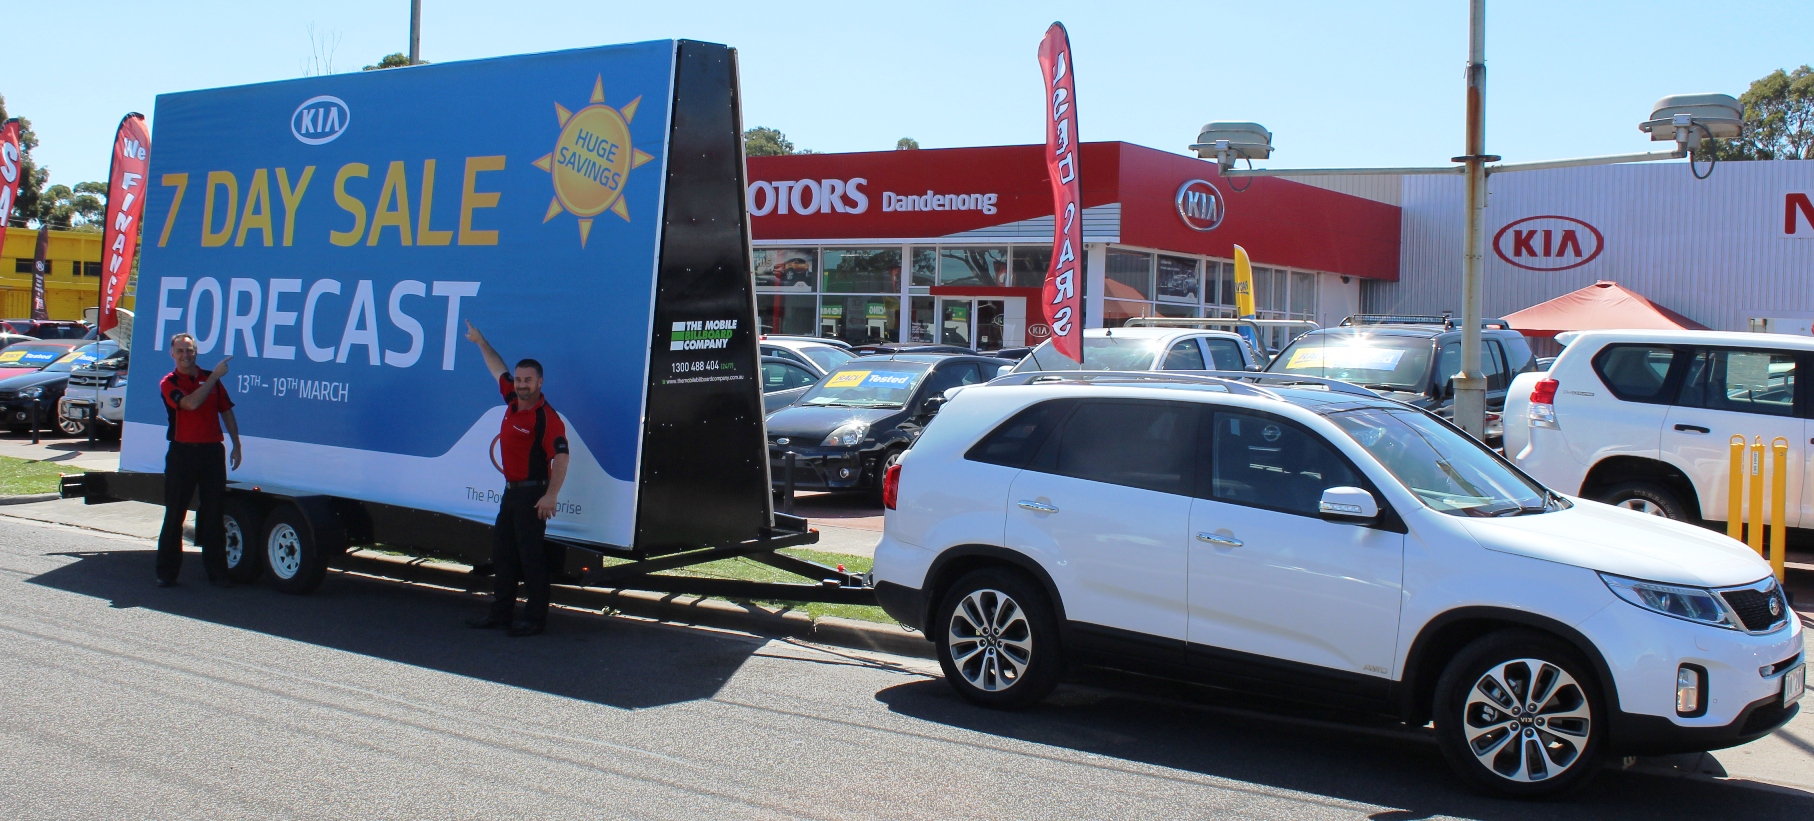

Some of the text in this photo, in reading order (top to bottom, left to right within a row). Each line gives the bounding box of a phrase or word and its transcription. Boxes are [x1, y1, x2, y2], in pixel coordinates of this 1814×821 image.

[301, 108, 339, 134] KIA
[123, 137, 146, 161] We
[575, 128, 619, 163] HUGE
[557, 146, 621, 191] SAVINGS
[158, 155, 506, 248] 7 DAY SALE
[748, 178, 998, 216] OTORS Dandenong
[1187, 190, 1217, 222] KIA
[105, 172, 142, 315] FINANCE
[1513, 229, 1583, 258] KIA
[154, 276, 481, 371] FORECAST
[685, 330, 733, 340] BILLBOARD
[686, 320, 738, 330] THE MOBILE
[684, 339, 728, 350] COMPANY
[671, 362, 690, 373] 1300
[691, 361, 705, 371] 488
[706, 360, 719, 370] 404
[868, 374, 909, 384] Tested
[238, 374, 261, 393] 13TH
[273, 377, 298, 397] 19TH
[299, 379, 349, 402] MARCH
[466, 486, 484, 501] The
